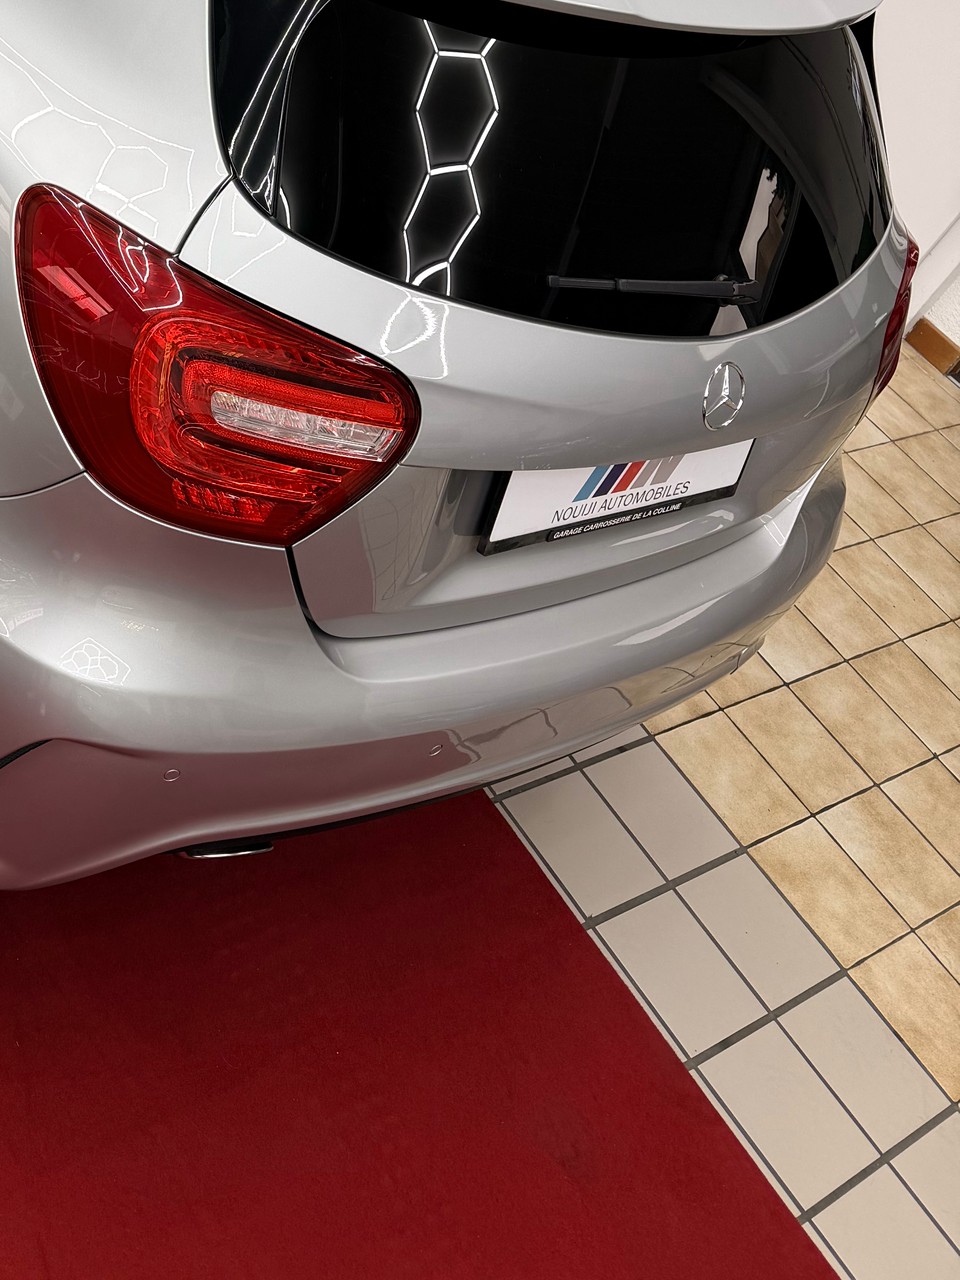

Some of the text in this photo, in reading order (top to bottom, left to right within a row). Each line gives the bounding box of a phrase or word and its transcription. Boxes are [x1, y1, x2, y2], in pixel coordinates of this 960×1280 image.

[551, 481, 691, 524] NOUIJI AUTOMOBILES
[553, 502, 682, 539] GARAGE CARROSSERIE DE LA COLLINE
